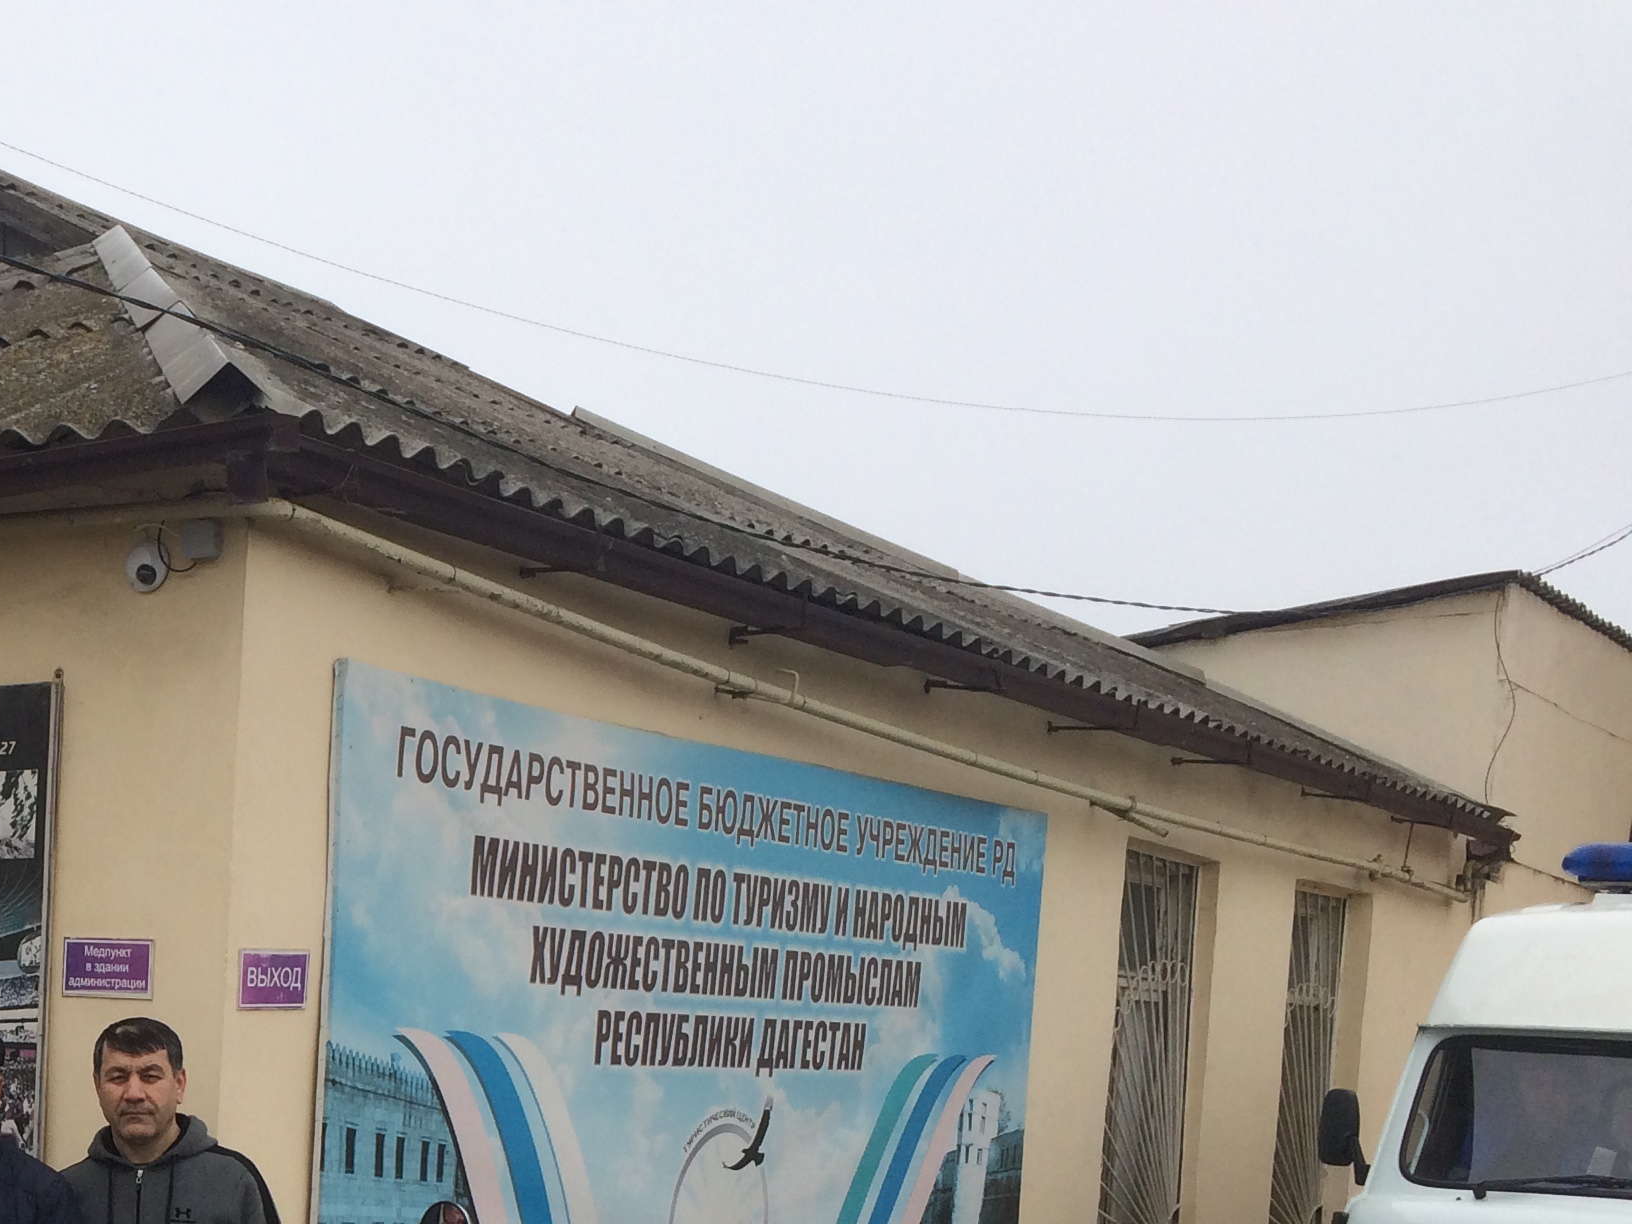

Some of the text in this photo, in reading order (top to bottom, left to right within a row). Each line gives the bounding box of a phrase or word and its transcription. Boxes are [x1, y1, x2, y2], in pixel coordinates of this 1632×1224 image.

[0, 741, 17, 756] 27
[396, 725, 1017, 887] ГОСУДАРСТВЕННОЕ БЮДЖЕТНОЕ УЧРЕЖДЕНИЕ РД
[470, 835, 966, 951] МИНИСТЕРСТВО ПО ТУРИЗМУ И НАРОДНЫМ
[84, 945, 132, 959] Медпункт
[85, 963, 129, 974] в здании
[247, 966, 302, 991] ВЫХОД
[529, 925, 921, 1009] ХУДОЖЕСТВЕННЫМ ПРОМЫСЛАМ
[68, 976, 146, 990] администрации
[594, 1009, 867, 1076] РЕСПУБЛИКИ ДАГЕСТАН
